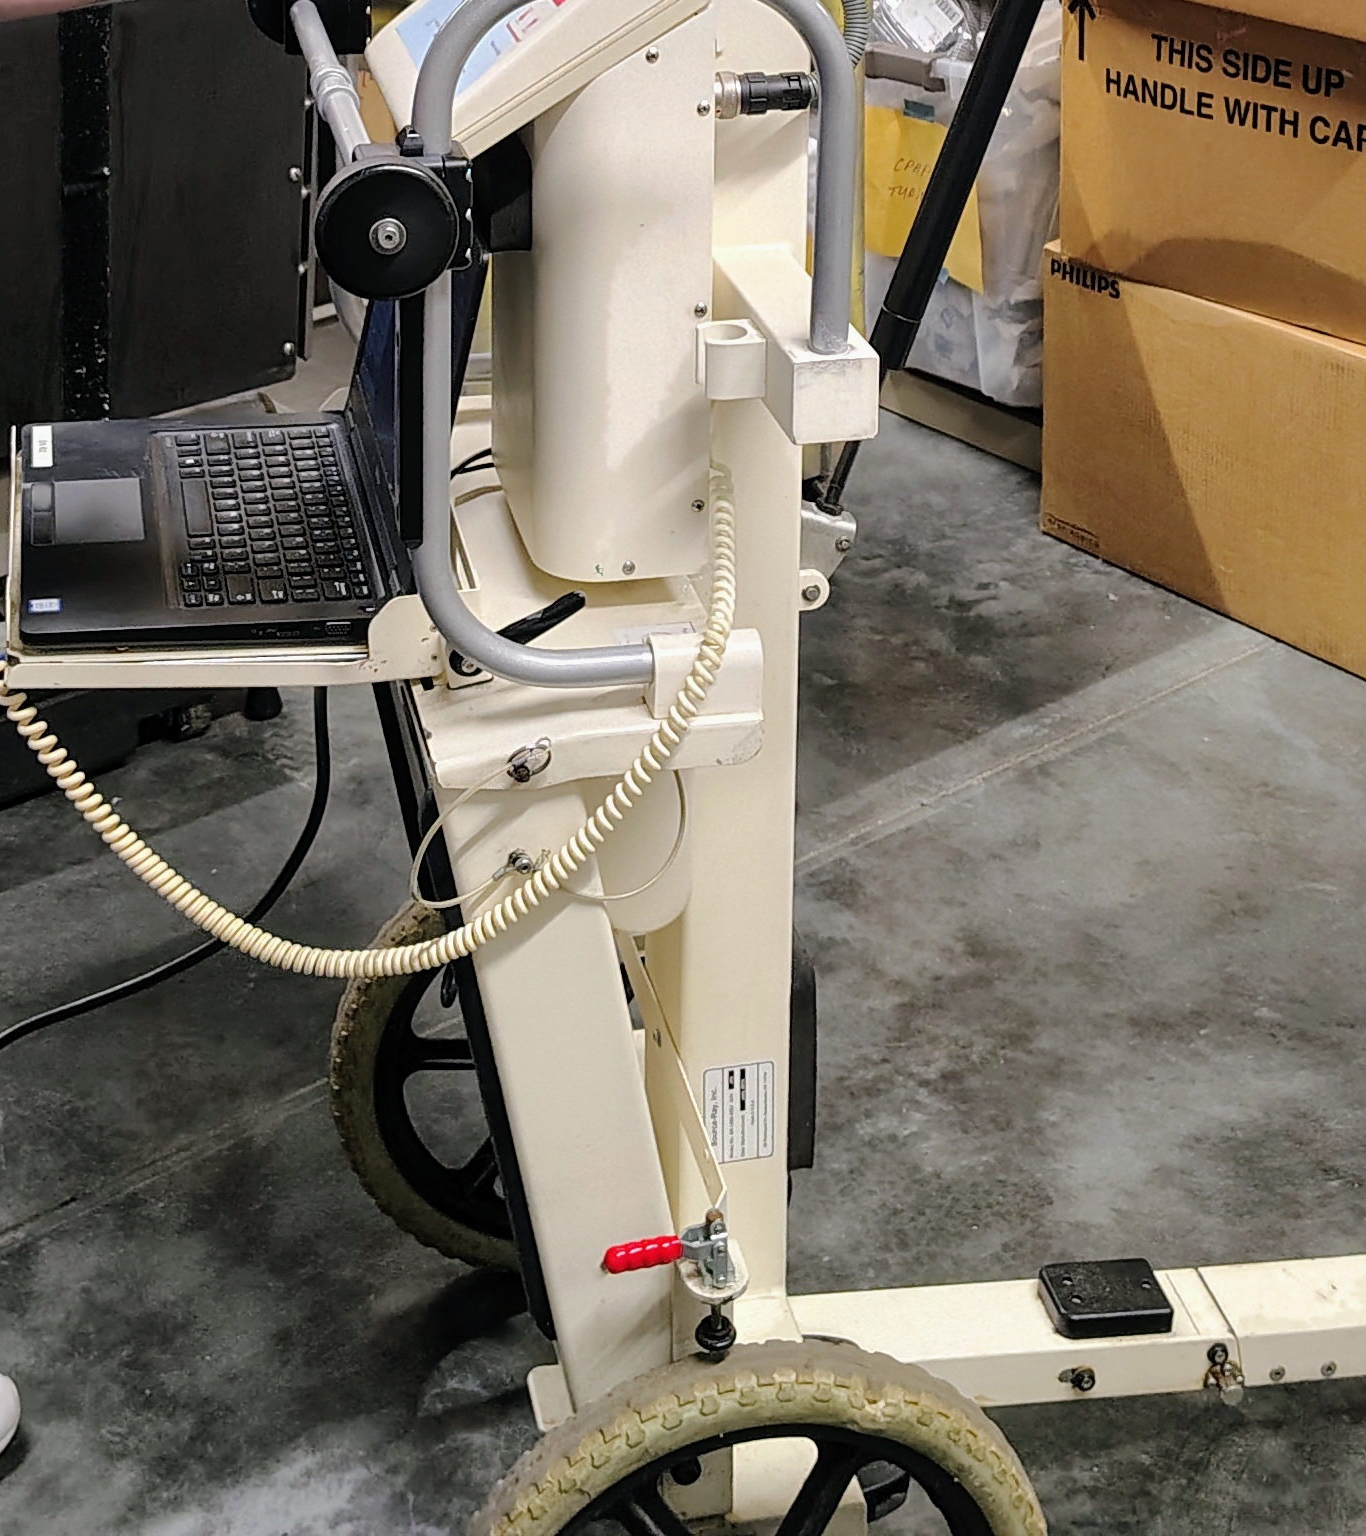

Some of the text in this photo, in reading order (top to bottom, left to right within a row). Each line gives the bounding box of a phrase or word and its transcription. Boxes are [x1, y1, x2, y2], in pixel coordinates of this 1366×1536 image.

[1151, 33, 1345, 97] THIS SIDE UP
[1105, 68, 1214, 120] HANDLE
[1223, 96, 1300, 139] WITH
[1050, 257, 1120, 299] PHILIPS
